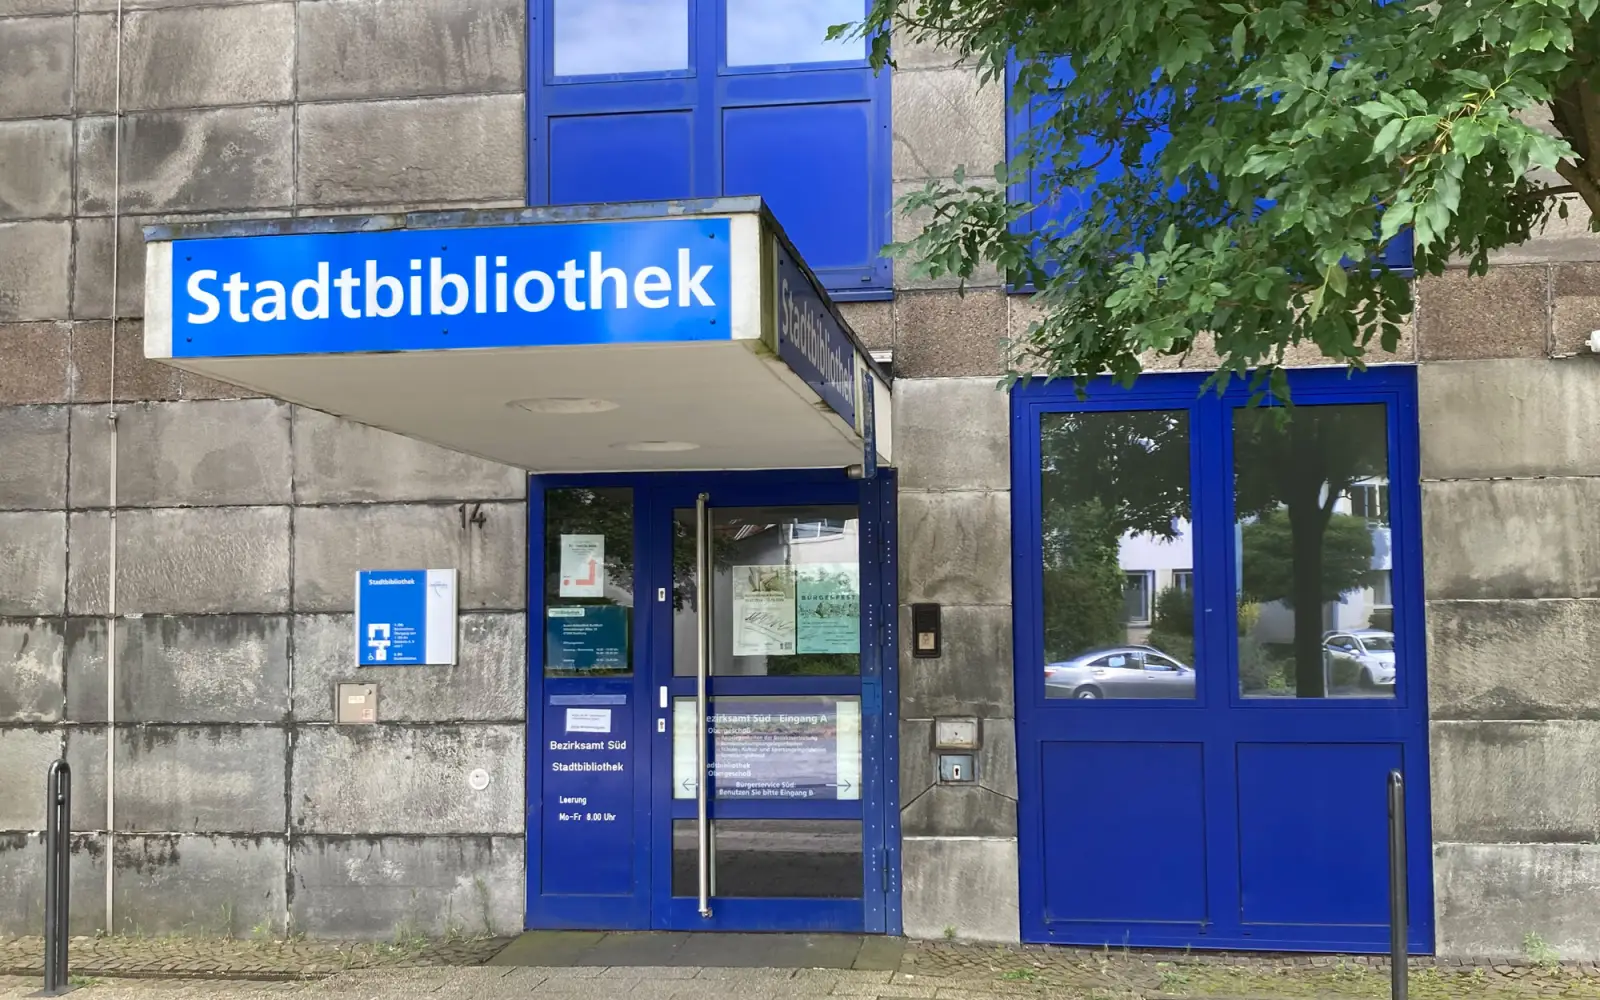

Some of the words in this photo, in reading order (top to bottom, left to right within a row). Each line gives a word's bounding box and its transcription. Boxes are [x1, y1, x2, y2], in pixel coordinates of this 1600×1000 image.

[186, 248, 715, 324] Stadtbibliothek
[782, 278, 854, 407] Stadtbibliothek
[459, 502, 487, 529] 14
[368, 578, 415, 586] Stadtbibliothek
[706, 714, 750, 723] ezirksamt
[753, 714, 771, 723] Süd
[779, 714, 817, 725] Eingang
[820, 714, 828, 723] A
[550, 741, 604, 750] Bezirksamt
[607, 741, 627, 750] Süd
[552, 762, 624, 771] Stadtbibliothek
[735, 781, 780, 790] Bürgerservice
[780, 789, 808, 798] Eingang
[559, 795, 587, 806] Leerung
[559, 812, 582, 821] Mo-Fr
[586, 812, 602, 821] 8.00
[603, 812, 616, 821] Uhr
